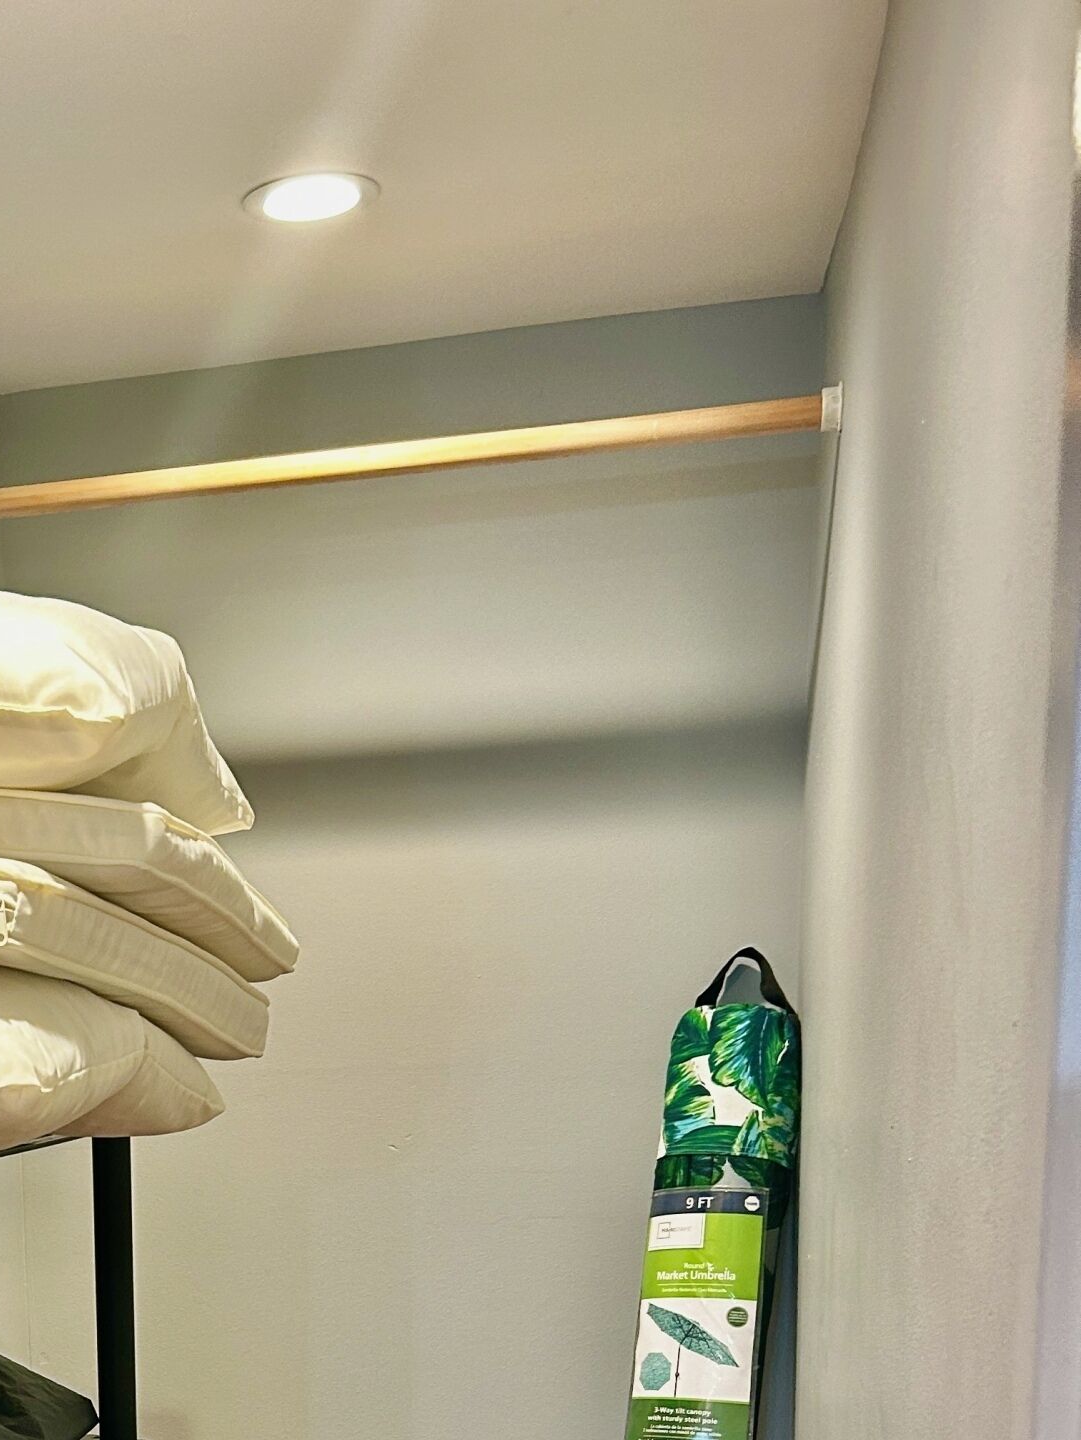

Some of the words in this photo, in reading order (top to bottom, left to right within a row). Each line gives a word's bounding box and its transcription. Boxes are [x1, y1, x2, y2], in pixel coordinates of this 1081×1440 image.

[686, 1198, 693, 1209] 9
[698, 1197, 714, 1208] FT
[657, 1272, 688, 1280] Market
[691, 1271, 736, 1281] Umbrella
[687, 1409, 712, 1417] canopy
